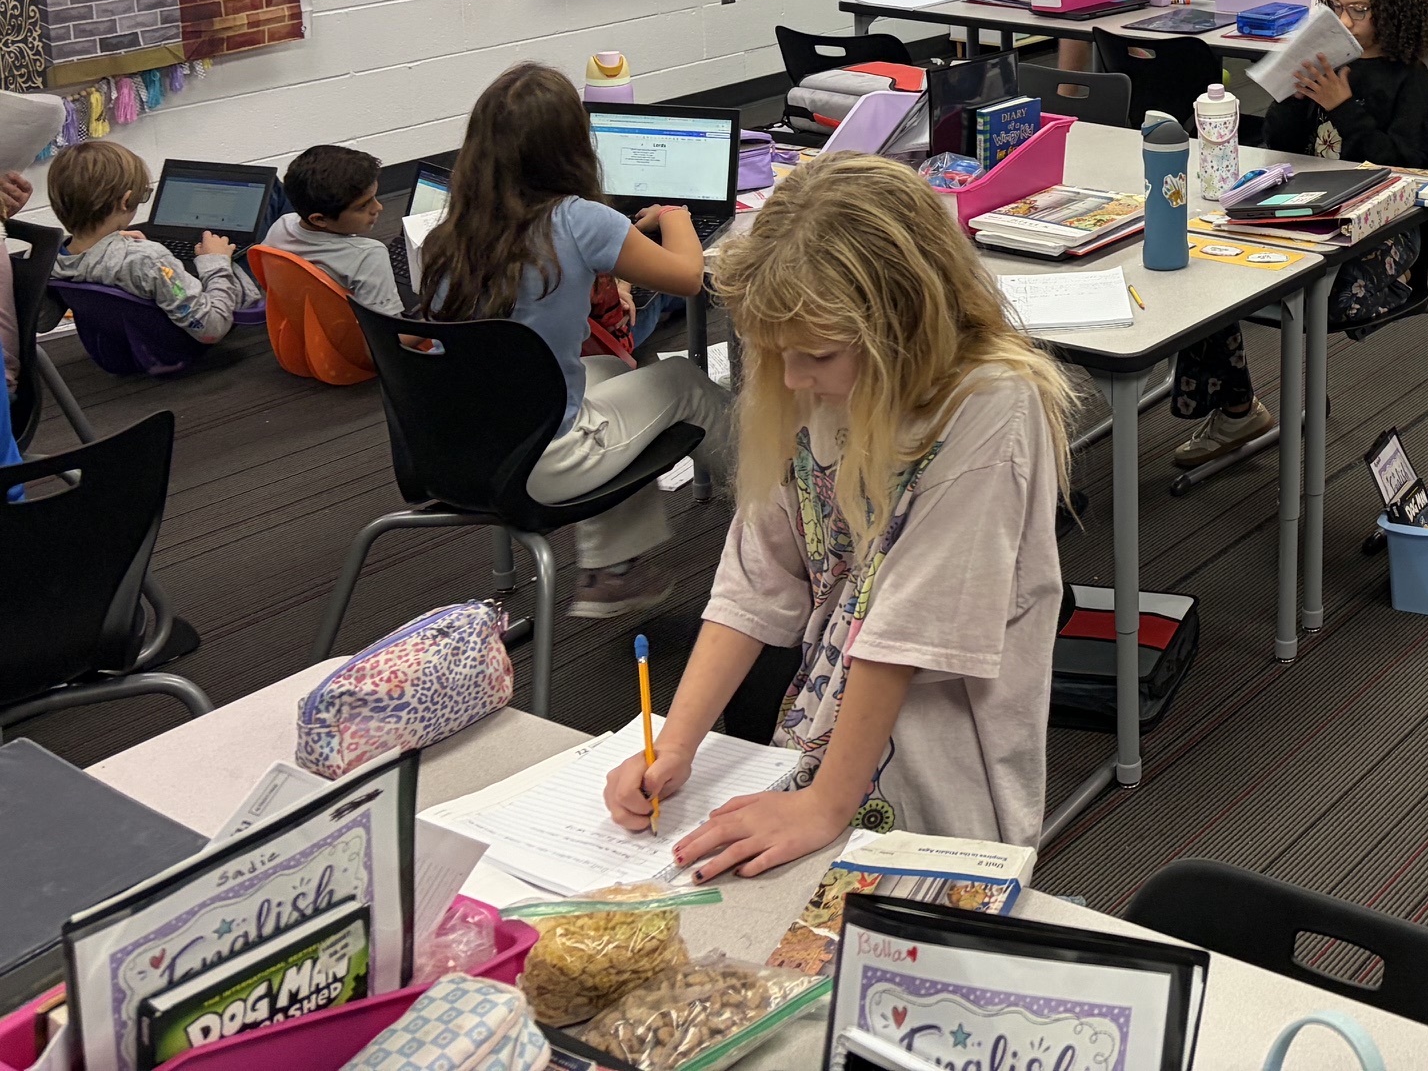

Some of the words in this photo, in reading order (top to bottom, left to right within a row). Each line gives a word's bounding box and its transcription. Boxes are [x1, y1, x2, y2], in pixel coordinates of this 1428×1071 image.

[1002, 107, 1028, 123] DIARY
[980, 853, 1008, 861] Empires
[985, 861, 1004, 869] Unit
[216, 850, 281, 888] Sadie
[857, 934, 907, 963] Bella
[186, 979, 271, 1049] DOG
[276, 953, 350, 1010] MAN
